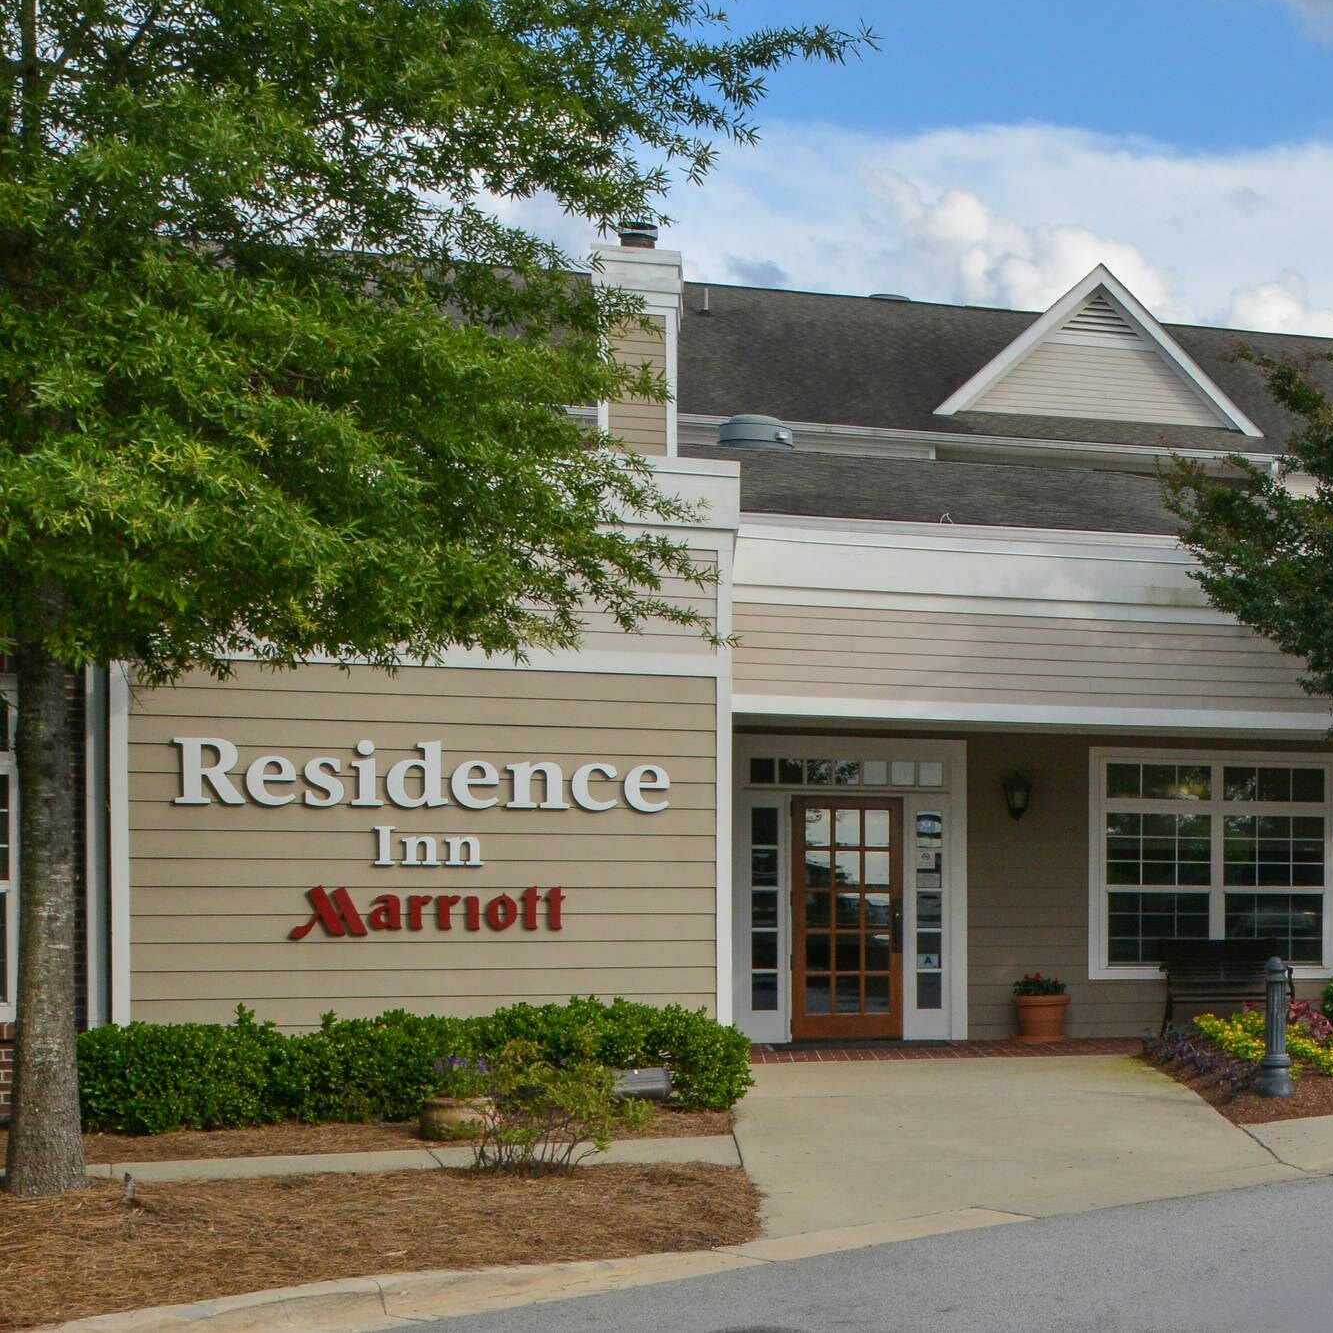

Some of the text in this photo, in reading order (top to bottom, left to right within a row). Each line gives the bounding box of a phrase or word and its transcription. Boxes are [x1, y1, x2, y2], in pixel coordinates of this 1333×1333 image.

[172, 736, 671, 813] Residence
[373, 825, 484, 868] Inn
[288, 885, 566, 941] Marriott
